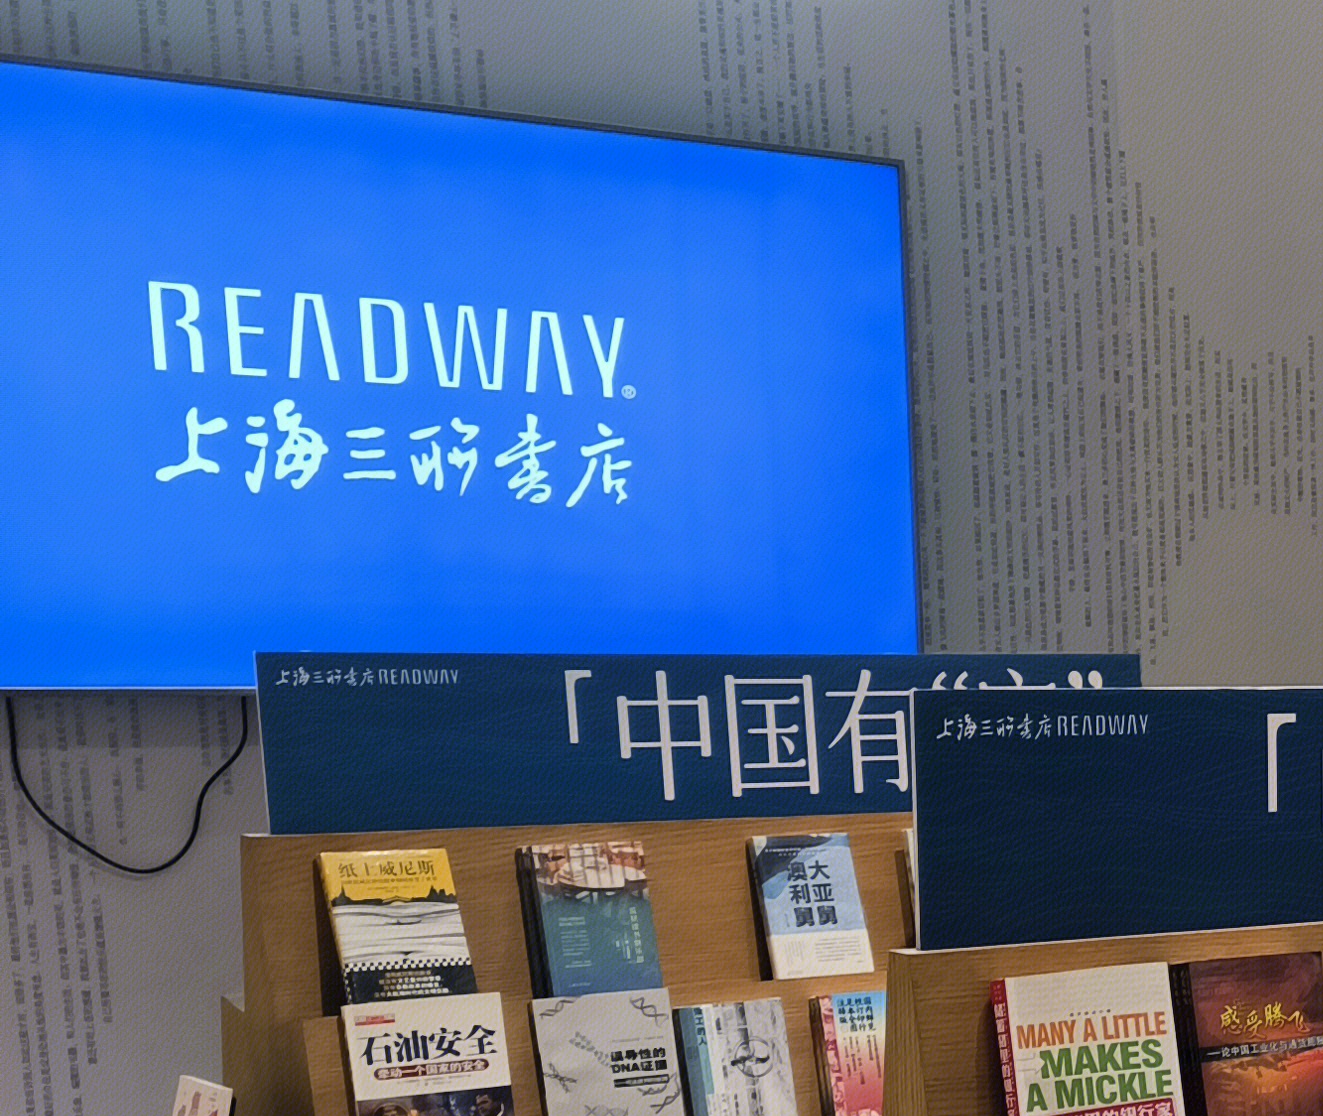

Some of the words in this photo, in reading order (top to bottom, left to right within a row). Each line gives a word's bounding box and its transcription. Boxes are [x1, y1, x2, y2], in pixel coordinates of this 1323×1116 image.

[147, 280, 626, 399] READWAY
[1056, 713, 1150, 738] READWAY
[1015, 1019, 1077, 1050] MANY
[1083, 1017, 1098, 1042] A
[1101, 1011, 1168, 1041] LITTLE
[1220, 1000, 1311, 1039] 感受腾飞
[356, 1024, 498, 1066] 石油安全
[1038, 1038, 1164, 1079] MAKES
[1025, 1083, 1049, 1113] A
[1054, 1069, 1175, 1110] MICKLE
